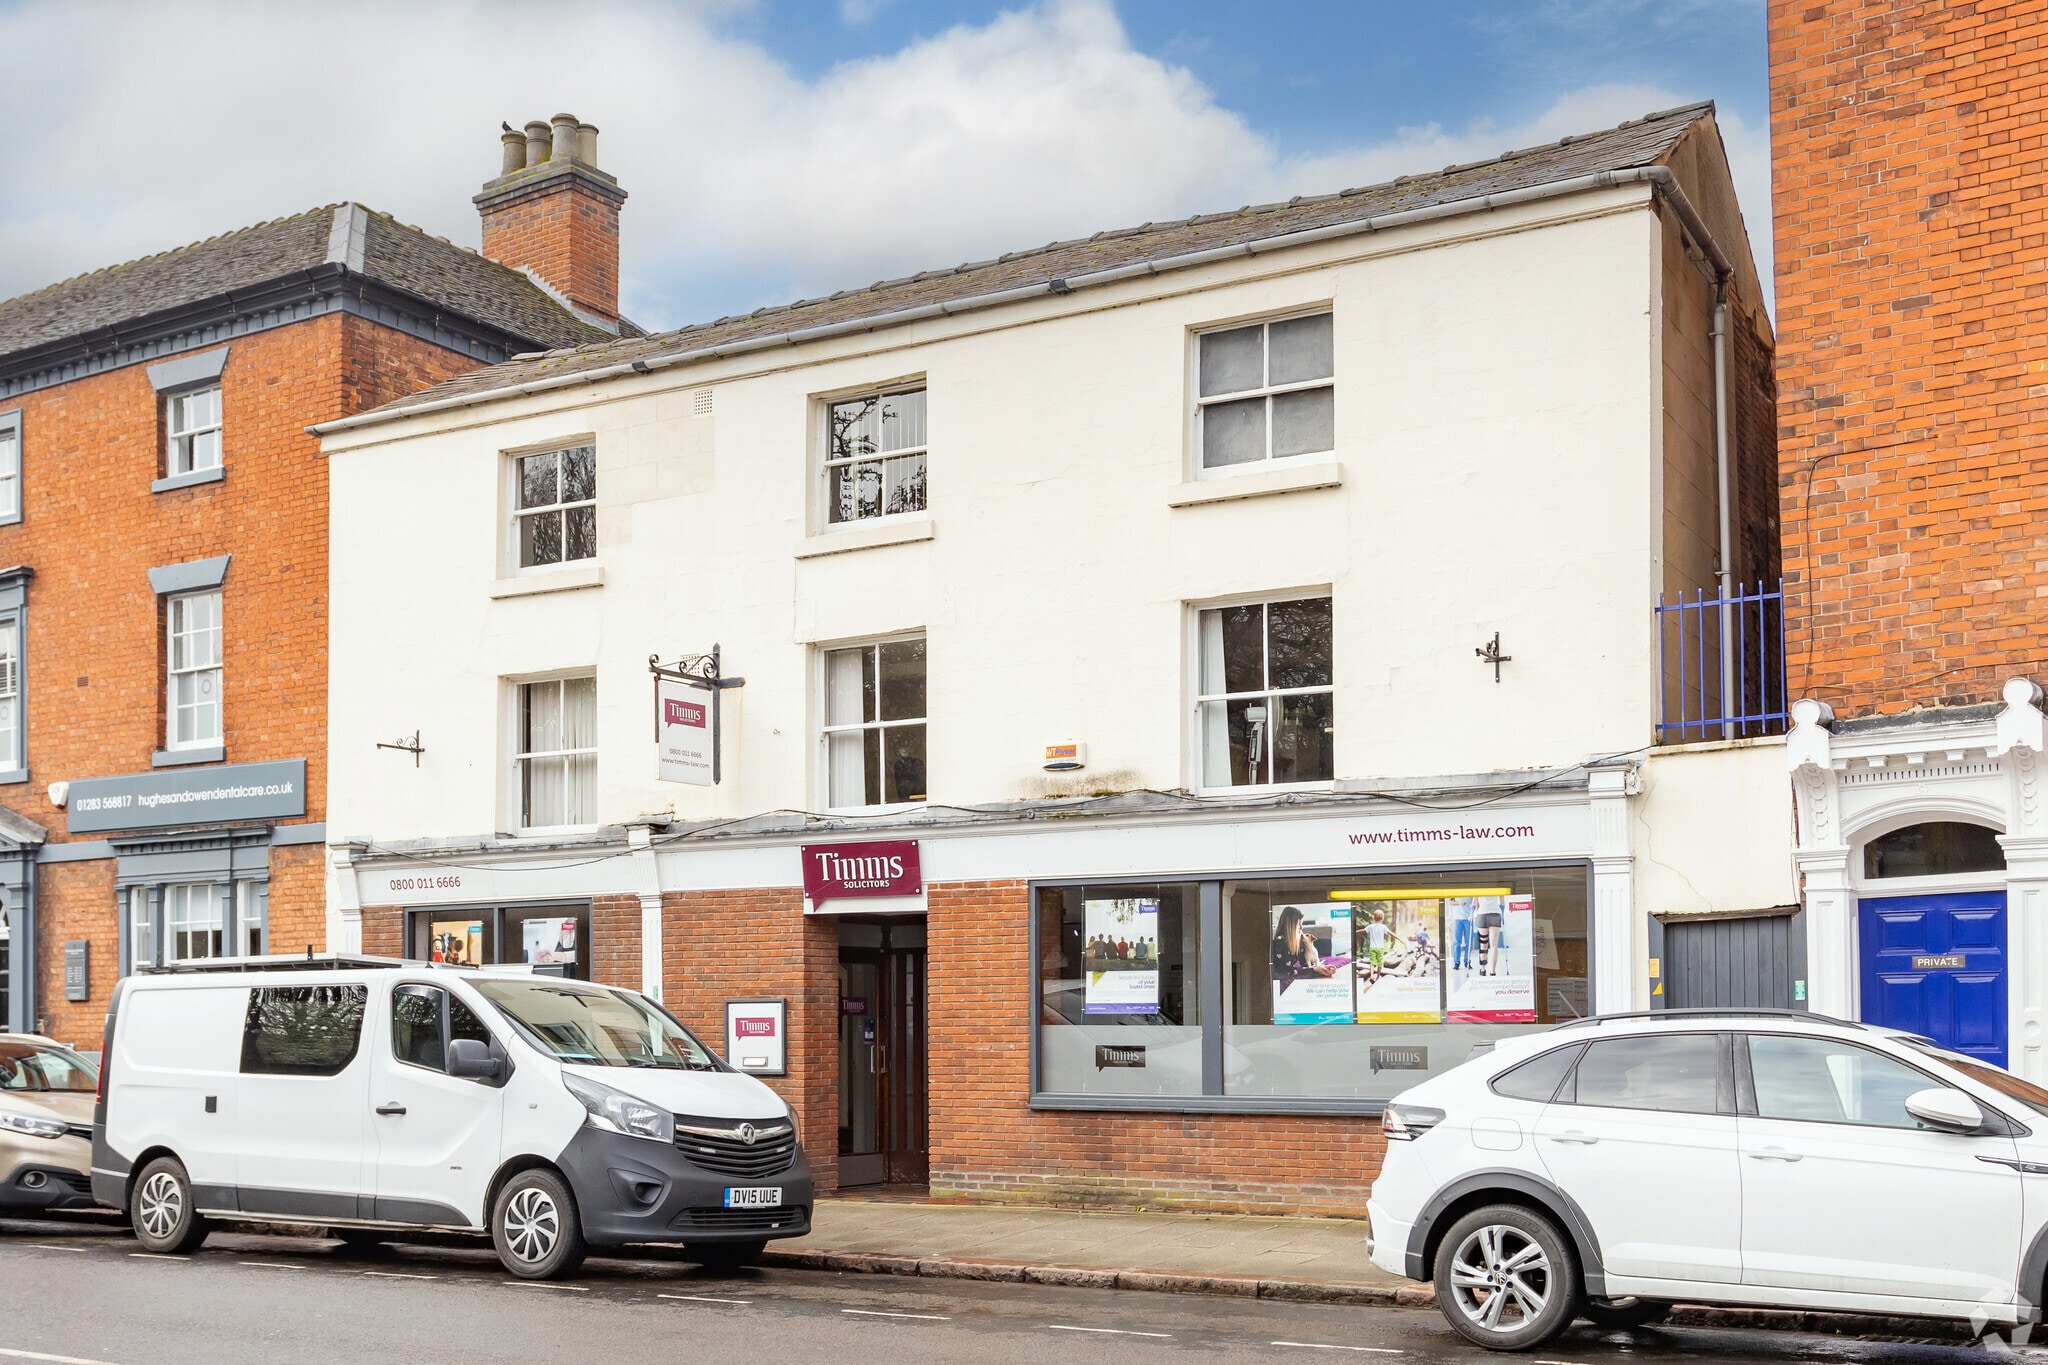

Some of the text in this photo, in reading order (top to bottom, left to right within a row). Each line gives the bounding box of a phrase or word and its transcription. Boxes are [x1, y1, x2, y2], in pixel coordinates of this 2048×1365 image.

[669, 702, 701, 721] Timms
[669, 748, 681, 756] 0800
[661, 758, 710, 769] www.timms-law.com
[77, 781, 293, 812] 01283 568817 hughesandowendentalcare.co.uk
[1348, 825, 1535, 844] www.timms-law.com
[815, 852, 904, 881] Timms
[390, 876, 461, 891] 0800 011 6666
[843, 879, 890, 889] SOLICITORS
[1917, 957, 1958, 967] PRIVATE
[739, 1020, 771, 1032] Timms
[1101, 1048, 1140, 1061] Timms
[1377, 1049, 1421, 1063] Timms
[733, 1189, 778, 1204] DV15 UUE
